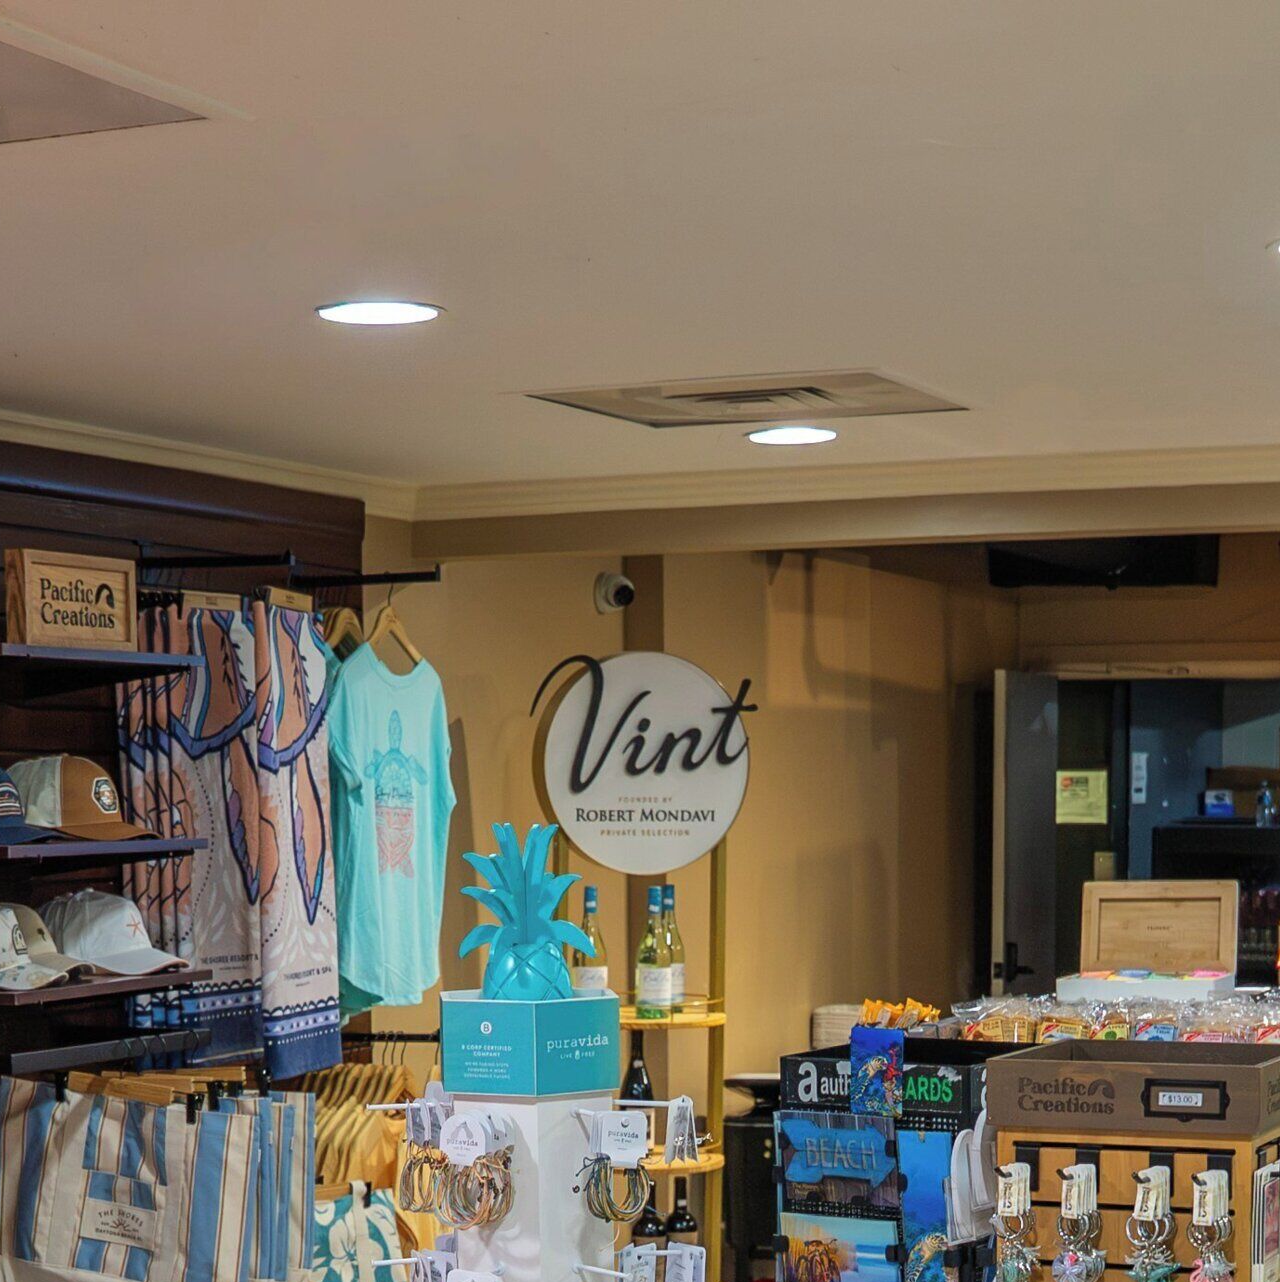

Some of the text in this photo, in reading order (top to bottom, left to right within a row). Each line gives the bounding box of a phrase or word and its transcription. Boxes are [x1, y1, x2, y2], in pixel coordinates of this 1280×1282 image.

[39, 577, 93, 605] Pacific
[41, 601, 115, 629] Creations
[529, 654, 759, 795] Vint
[575, 808, 715, 822] ROBERT MONDAVI
[546, 1034, 609, 1053] puravida
[905, 1076, 953, 1103] ARDS
[1017, 1077, 1087, 1096] Pacific
[1017, 1094, 1115, 1115] Creations
[1166, 1094, 1193, 1104] $13.00
[806, 1137, 877, 1170] BEACH
[98, 1209, 113, 1218] THE
